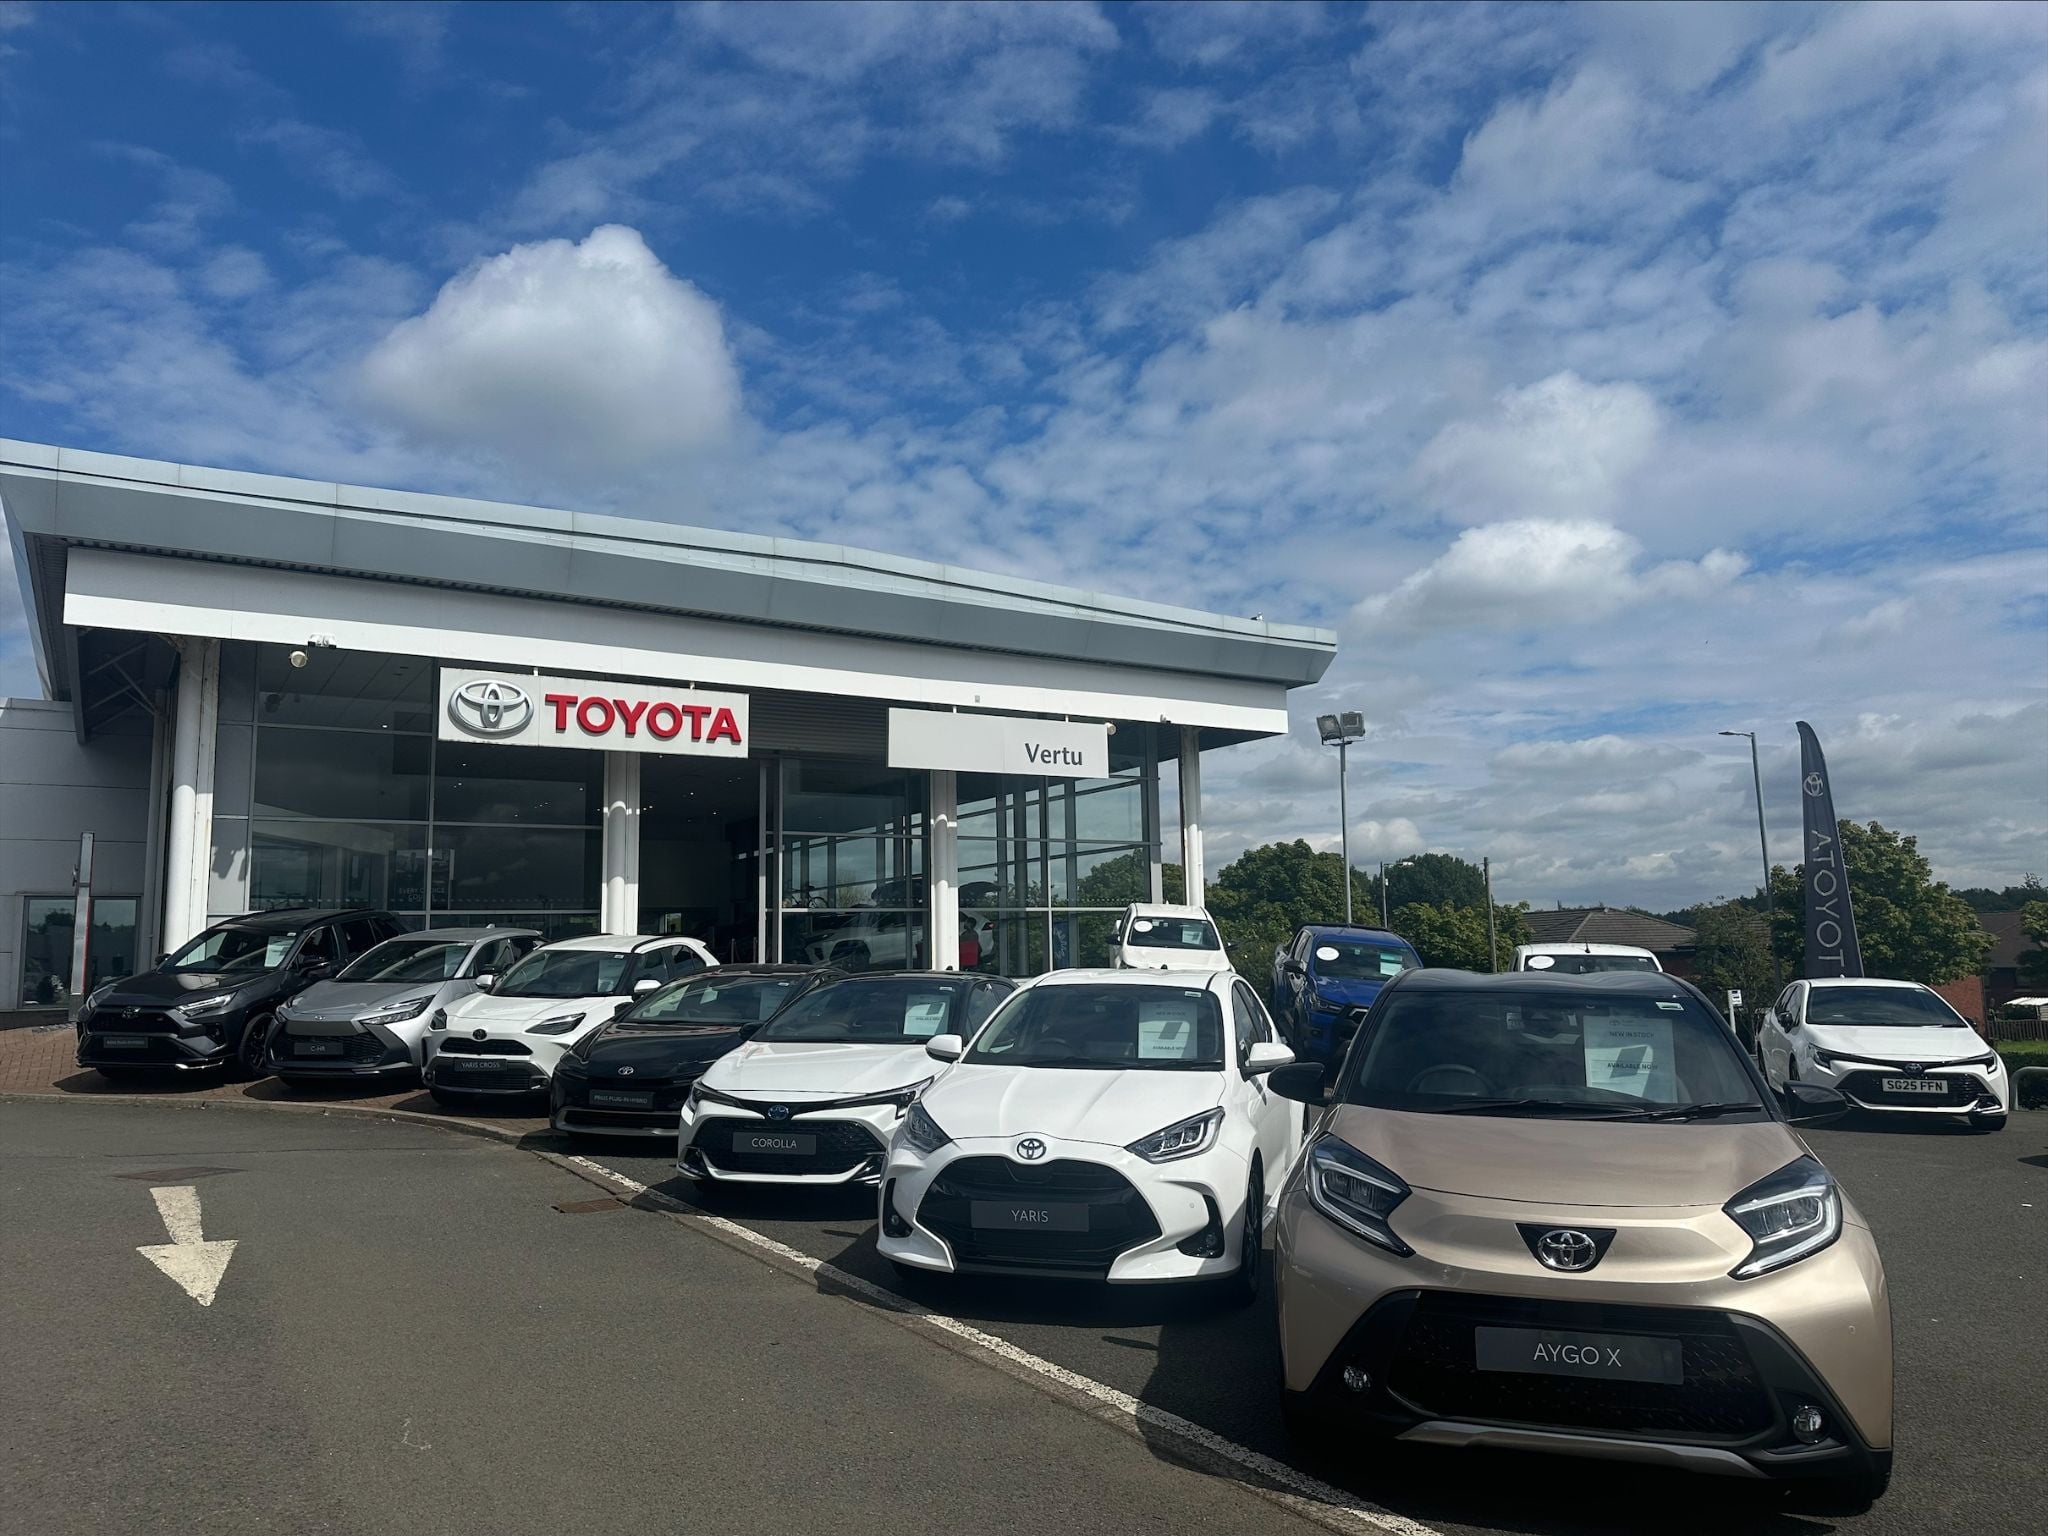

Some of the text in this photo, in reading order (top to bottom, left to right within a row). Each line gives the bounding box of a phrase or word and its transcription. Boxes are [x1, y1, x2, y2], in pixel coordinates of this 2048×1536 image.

[545, 693, 742, 743] TOYOTA
[1024, 742, 1083, 766] Vertu
[461, 1061, 501, 1069] YARIS CROSS
[1607, 1062, 1640, 1070] AVAILABLE
[1887, 1080, 1943, 1092] SG25 FFN
[751, 1137, 797, 1149] COROLLA
[1011, 1208, 1049, 1223] YARIS
[1533, 1342, 1622, 1368] AYGO X
